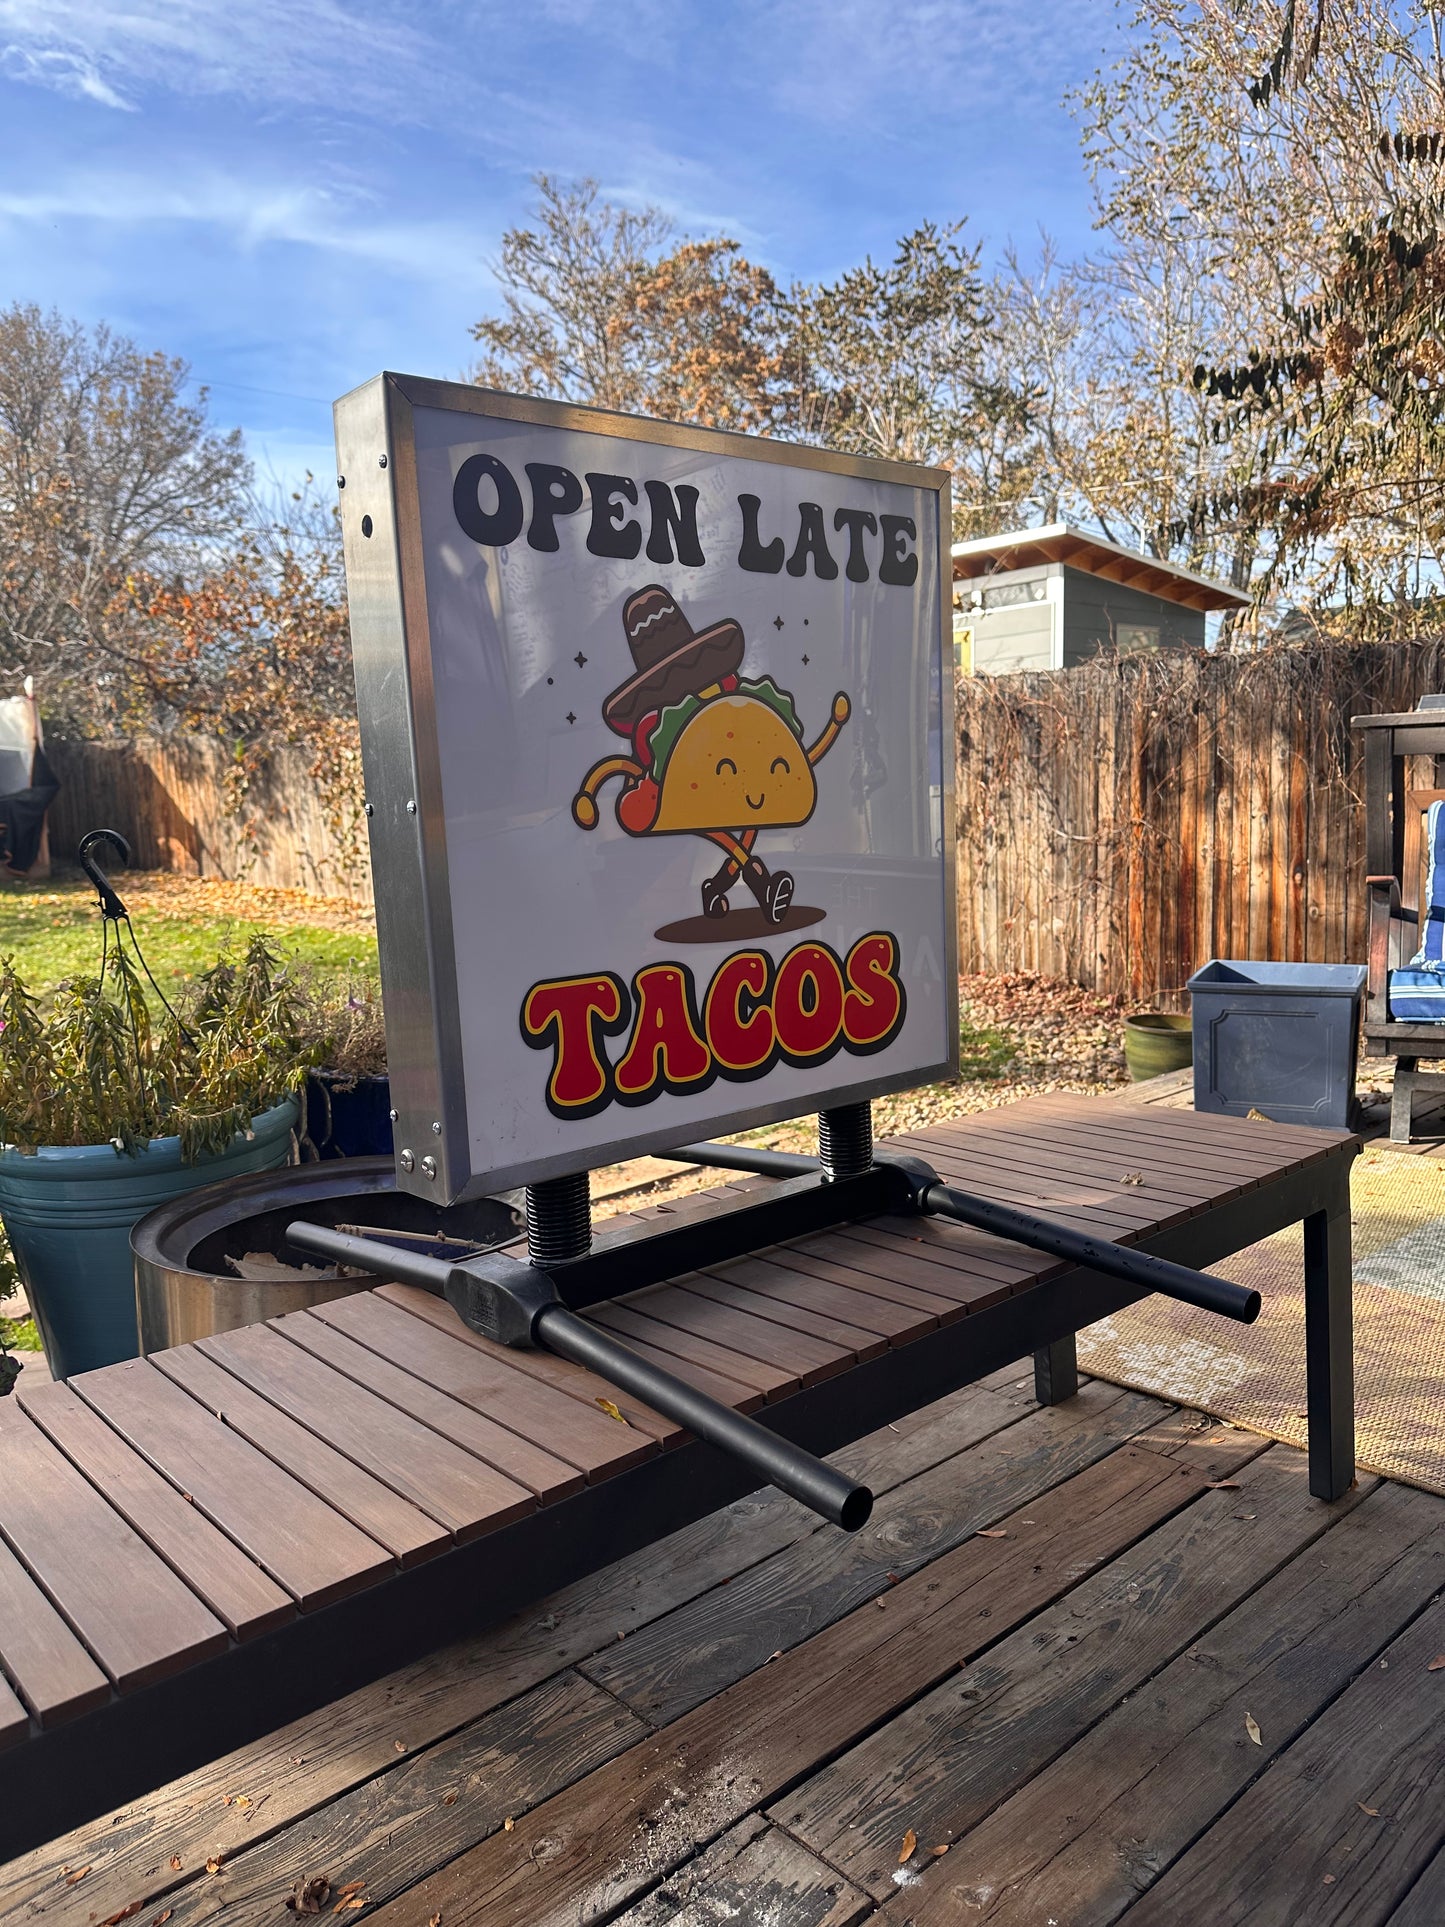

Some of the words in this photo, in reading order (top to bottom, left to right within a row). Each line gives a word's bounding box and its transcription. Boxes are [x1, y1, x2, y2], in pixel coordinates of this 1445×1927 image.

[453, 453, 706, 567] OPEN
[738, 494, 918, 587] LATE
[520, 931, 907, 1121] TACOS
